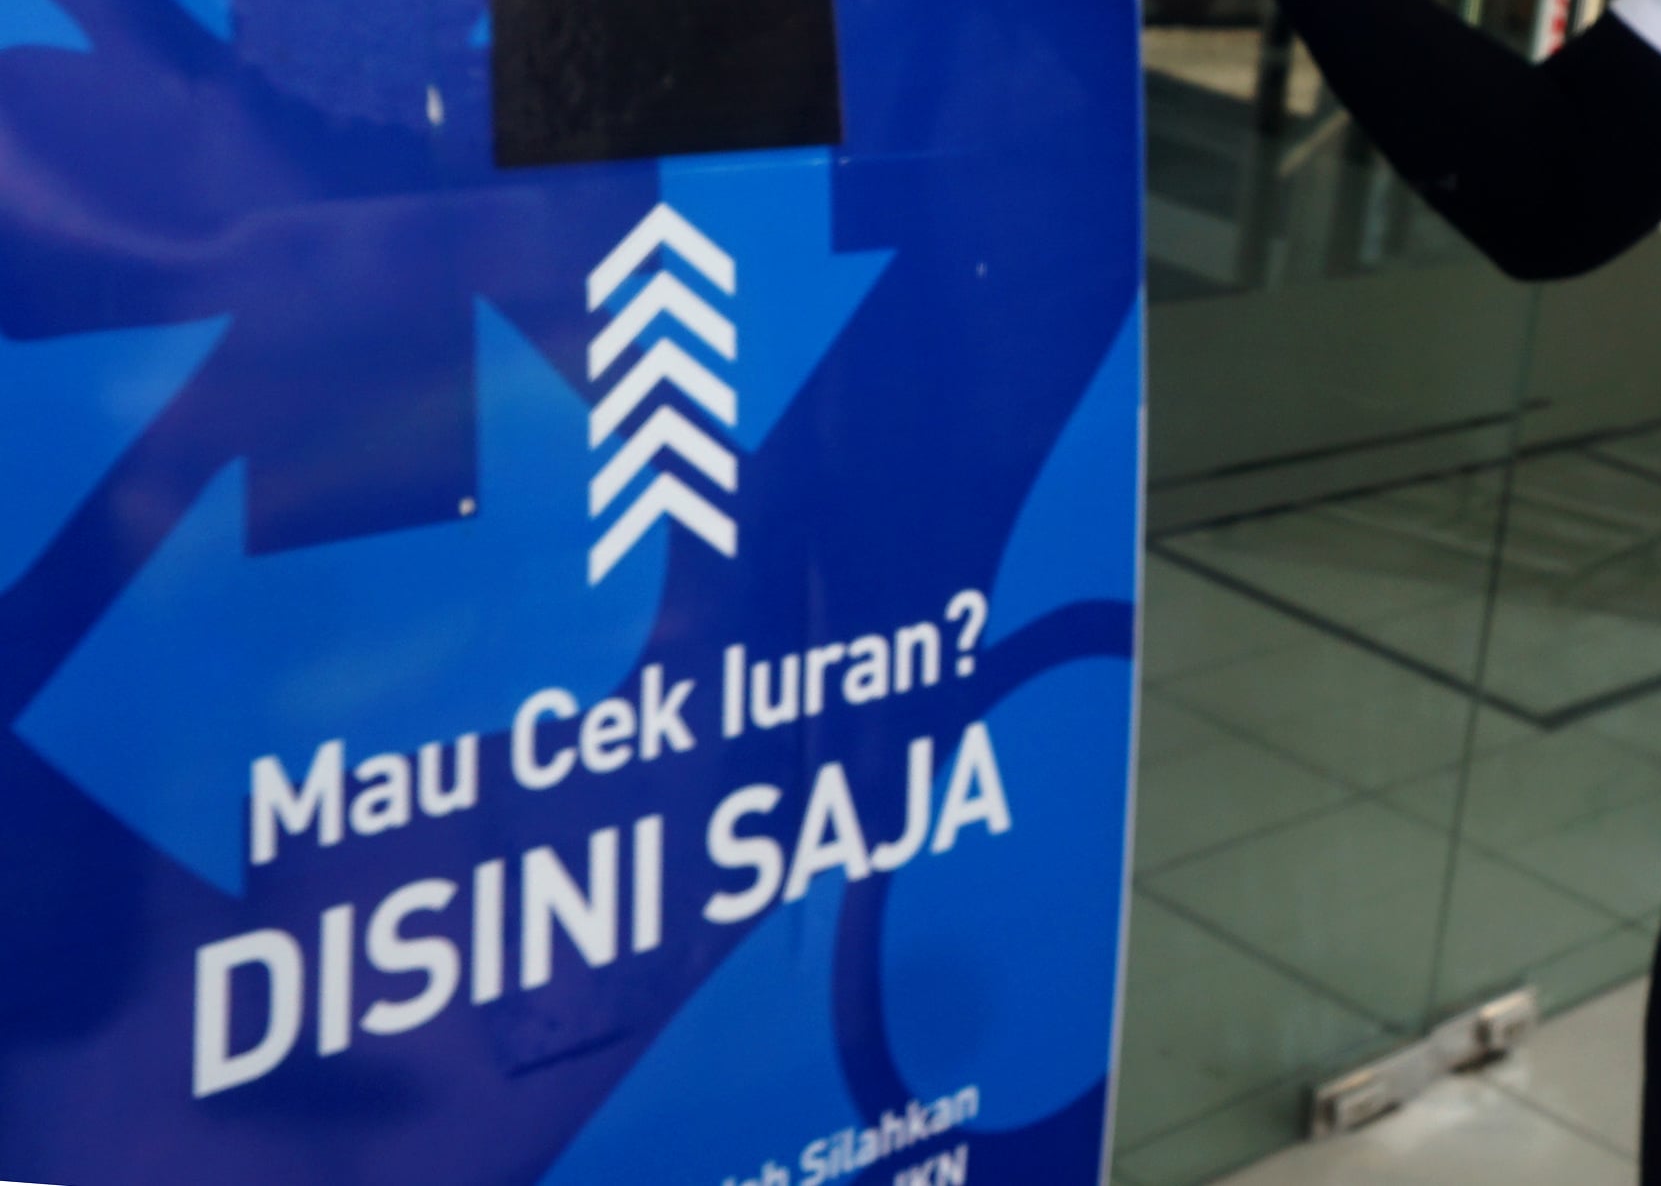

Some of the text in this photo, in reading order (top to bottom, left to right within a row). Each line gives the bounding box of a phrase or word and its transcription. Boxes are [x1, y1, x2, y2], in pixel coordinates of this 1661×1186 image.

[250, 589, 989, 866] Mau Cek Iuran?
[191, 720, 1012, 1100] DISINI SAJA
[799, 1083, 981, 1186] Silahkan
